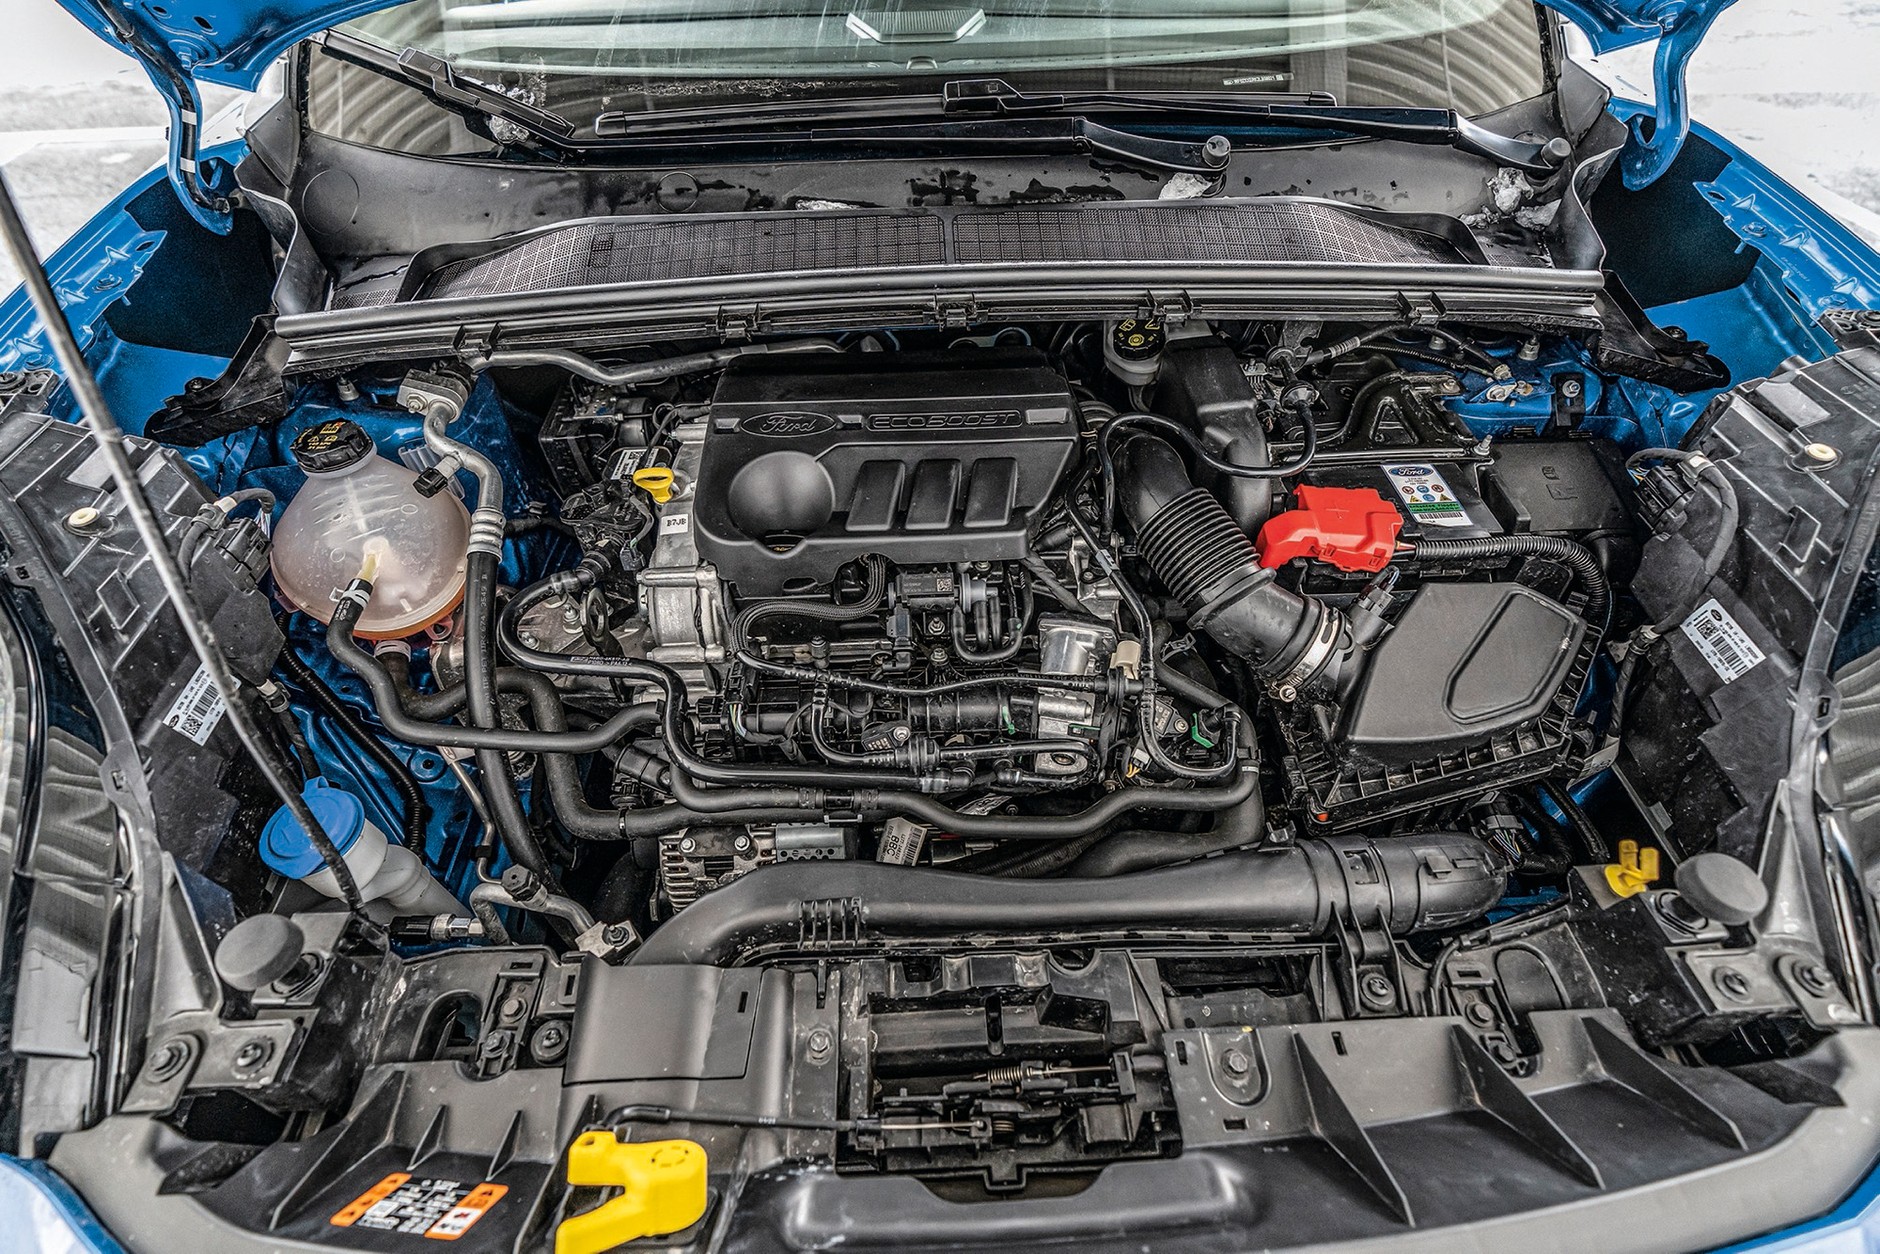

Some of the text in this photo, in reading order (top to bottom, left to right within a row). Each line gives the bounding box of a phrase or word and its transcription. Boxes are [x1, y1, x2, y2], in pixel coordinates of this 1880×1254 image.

[760, 415, 816, 432] Ford
[873, 413, 1017, 428] ECOBOOST
[1398, 467, 1425, 476] Ford
